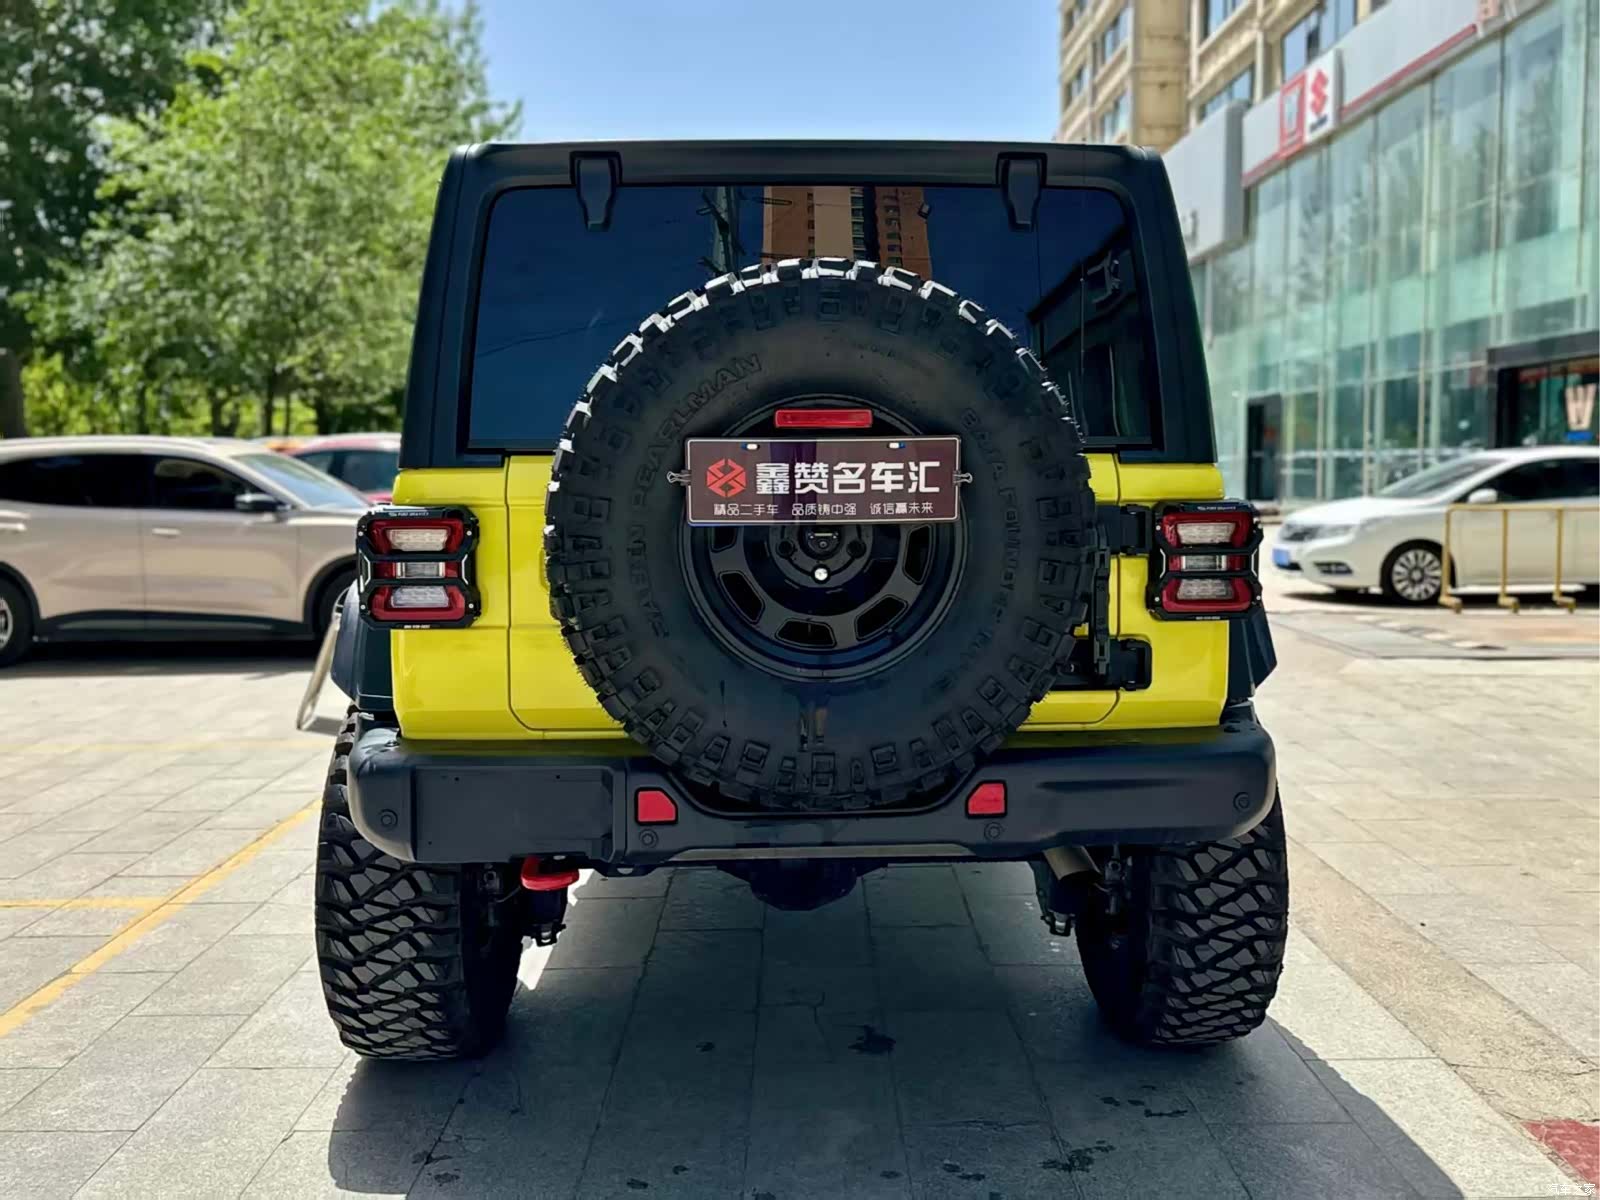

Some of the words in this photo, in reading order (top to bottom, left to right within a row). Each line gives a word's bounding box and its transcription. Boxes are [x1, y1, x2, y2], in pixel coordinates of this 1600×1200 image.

[755, 460, 940, 495] 鑫赞名车汇
[713, 502, 779, 517] 精品二手车
[870, 501, 934, 516] 诚信赢未来
